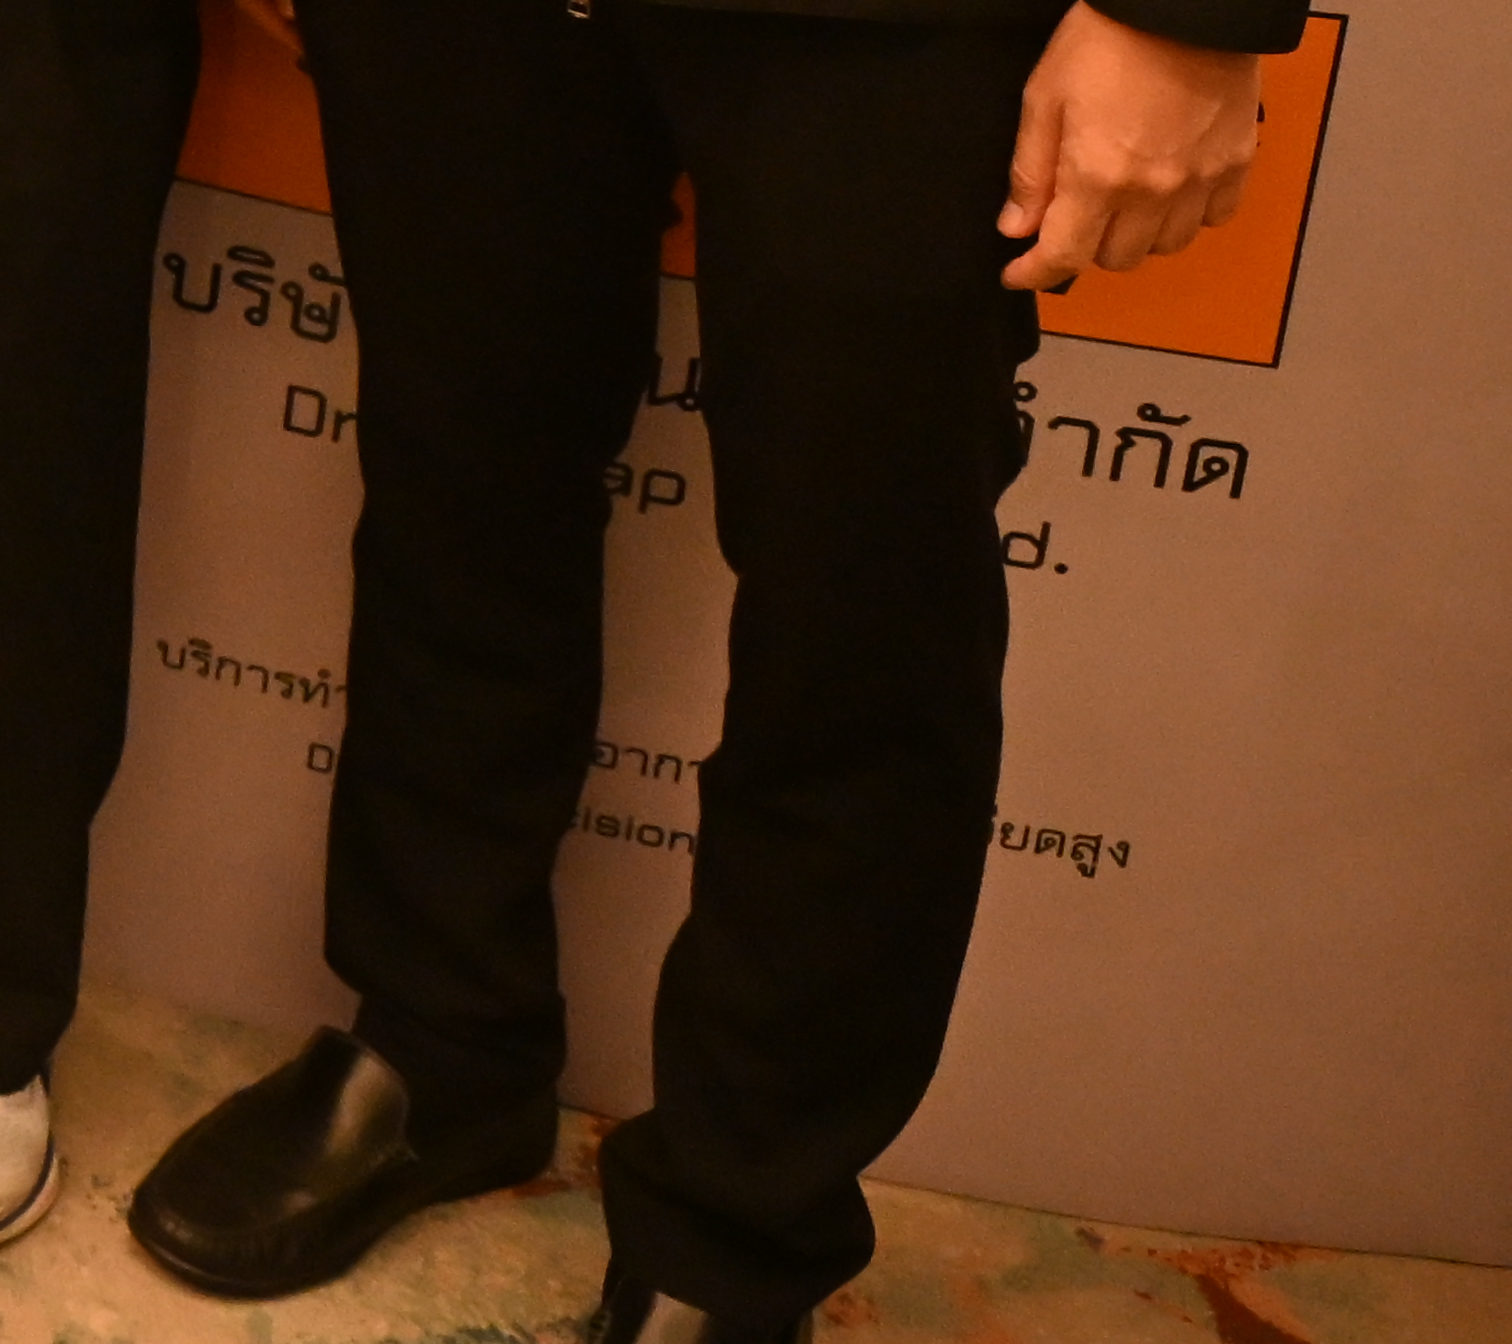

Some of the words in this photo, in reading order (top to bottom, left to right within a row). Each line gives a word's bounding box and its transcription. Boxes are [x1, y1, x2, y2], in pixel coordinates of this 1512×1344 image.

[162, 244, 345, 343] บริษั
[602, 463, 687, 515] ap
[1002, 521, 1068, 574] d.
